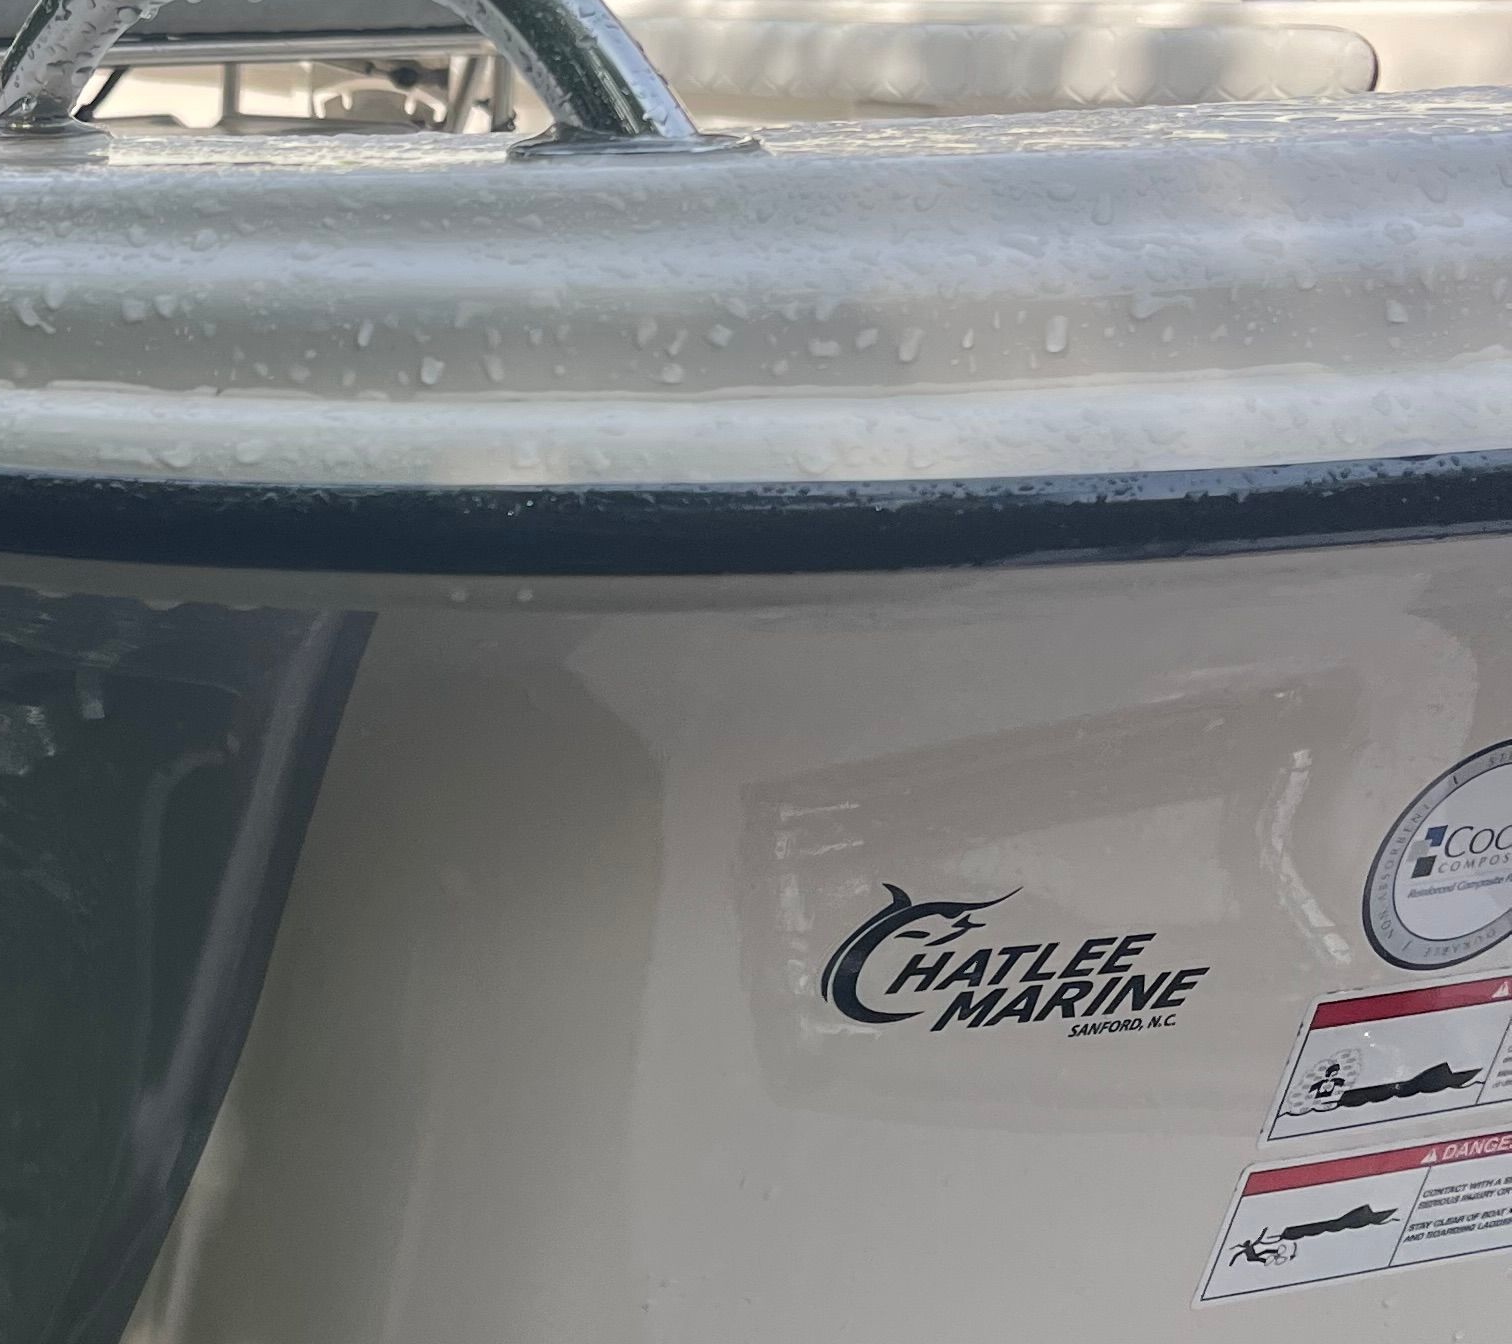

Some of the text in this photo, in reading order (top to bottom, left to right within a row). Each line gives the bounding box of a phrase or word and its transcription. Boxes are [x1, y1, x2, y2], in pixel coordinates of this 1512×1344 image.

[930, 966, 1210, 1033] MARINE
[1067, 1018, 1143, 1038] SANFORD,
[1441, 1134, 1512, 1161] DANGE
